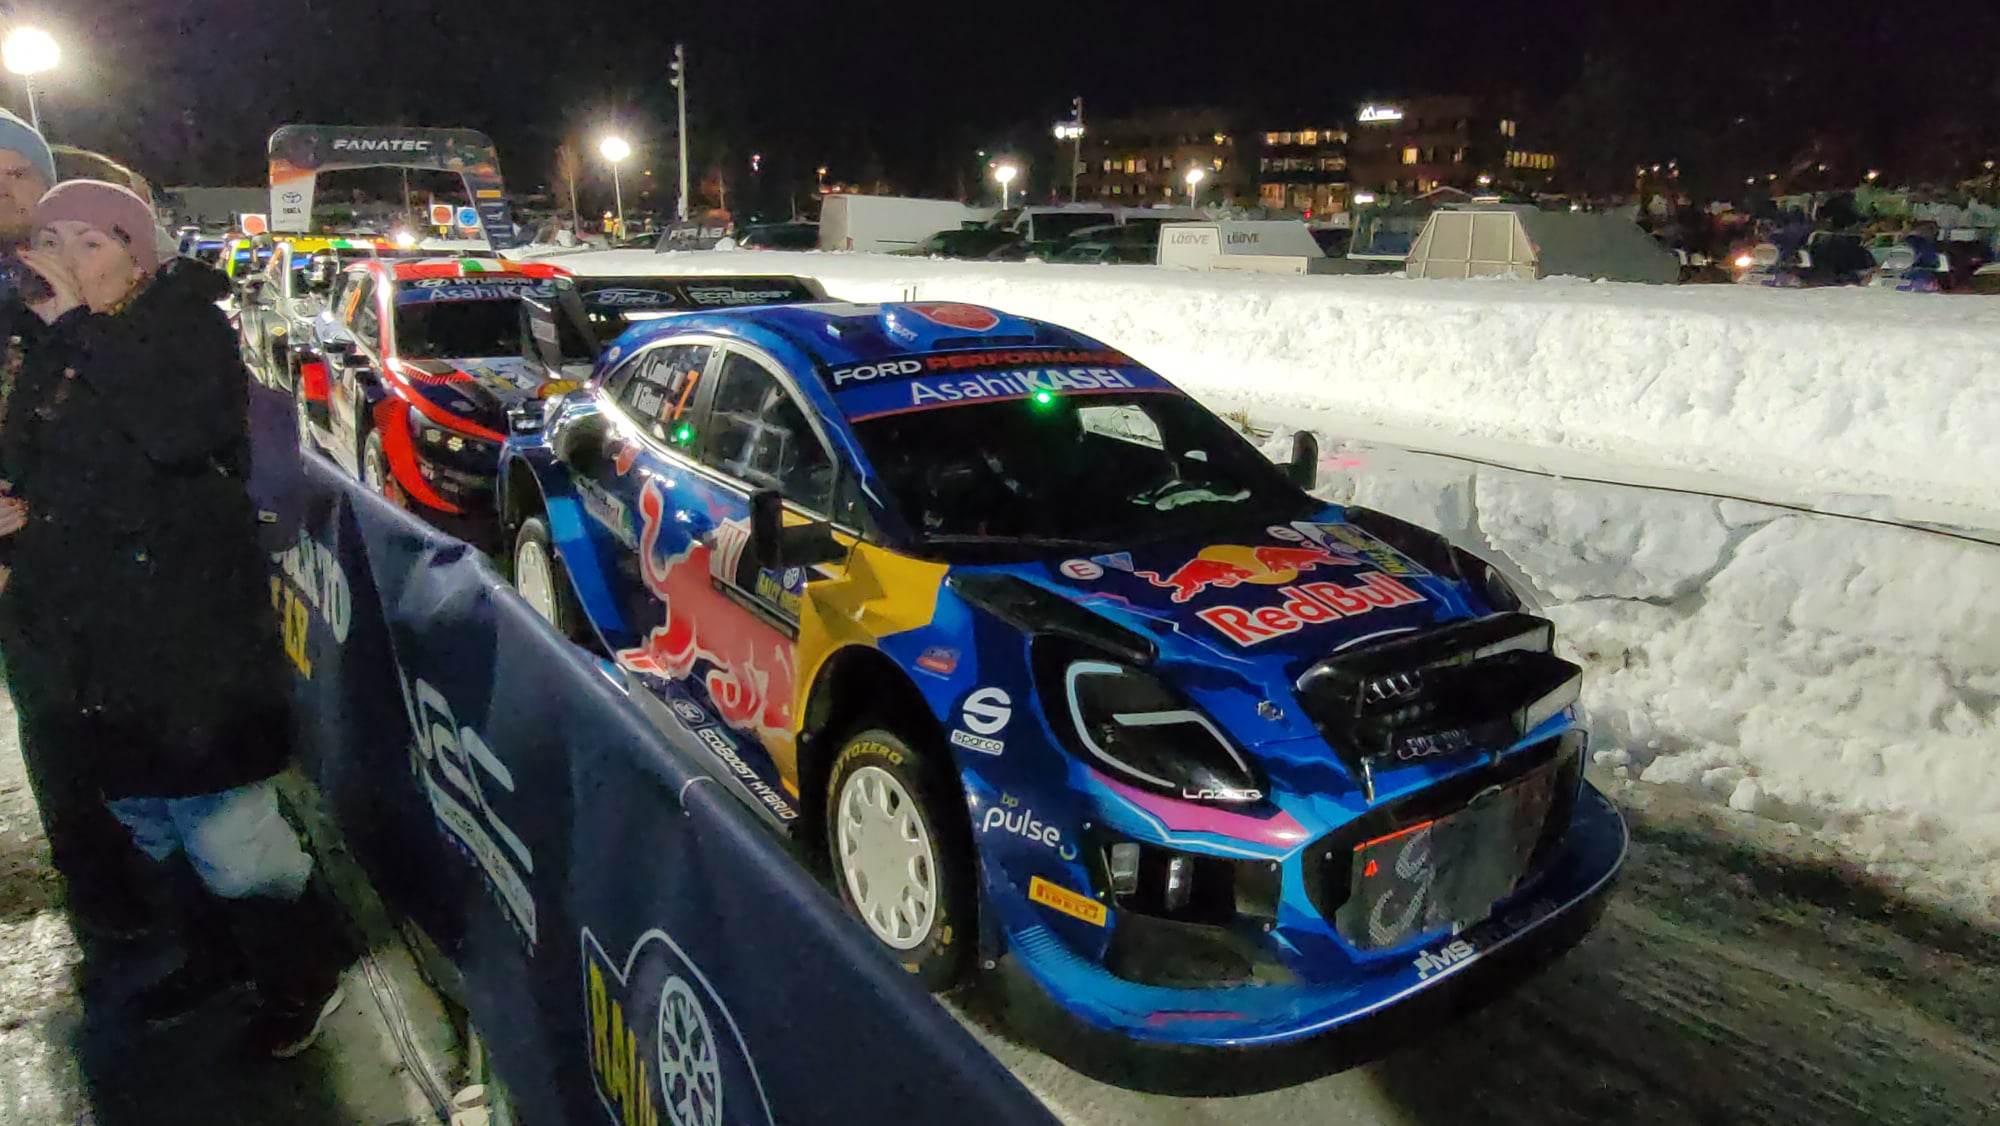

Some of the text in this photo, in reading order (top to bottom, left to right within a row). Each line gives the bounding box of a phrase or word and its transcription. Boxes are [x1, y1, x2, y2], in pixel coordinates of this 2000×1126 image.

[333, 139, 433, 151] FANATEC
[833, 360, 922, 386] FORD
[953, 731, 1002, 752] sparco
[751, 780, 799, 820] HYBRID
[1003, 793, 1019, 808] bp
[983, 807, 1061, 848] pulse
